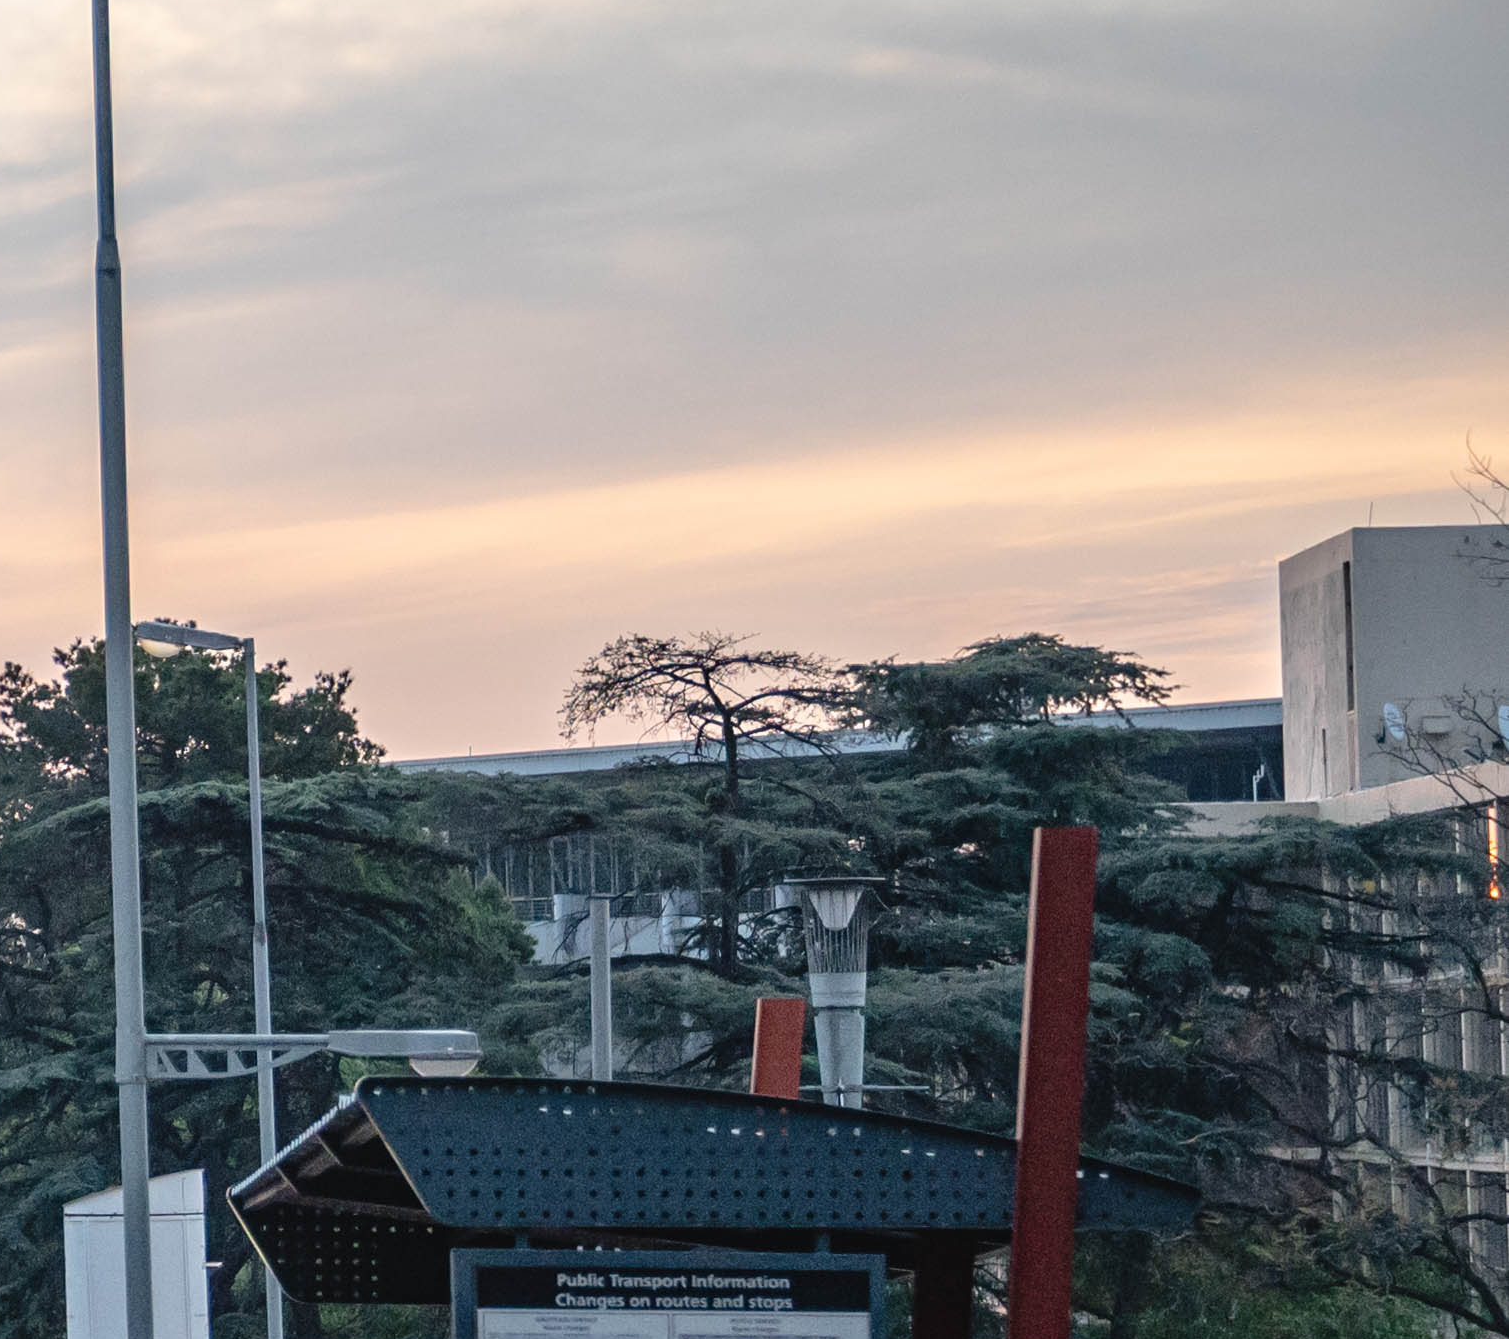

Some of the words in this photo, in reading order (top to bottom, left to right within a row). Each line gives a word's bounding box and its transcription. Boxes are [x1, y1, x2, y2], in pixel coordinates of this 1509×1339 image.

[557, 1273, 604, 1288] Public
[609, 1273, 687, 1290] Transport
[691, 1274, 791, 1290] Information
[555, 1293, 625, 1311] Changes
[629, 1298, 650, 1308] on
[655, 1296, 708, 1309] routes
[712, 1294, 745, 1309] and
[748, 1296, 794, 1311] stops
